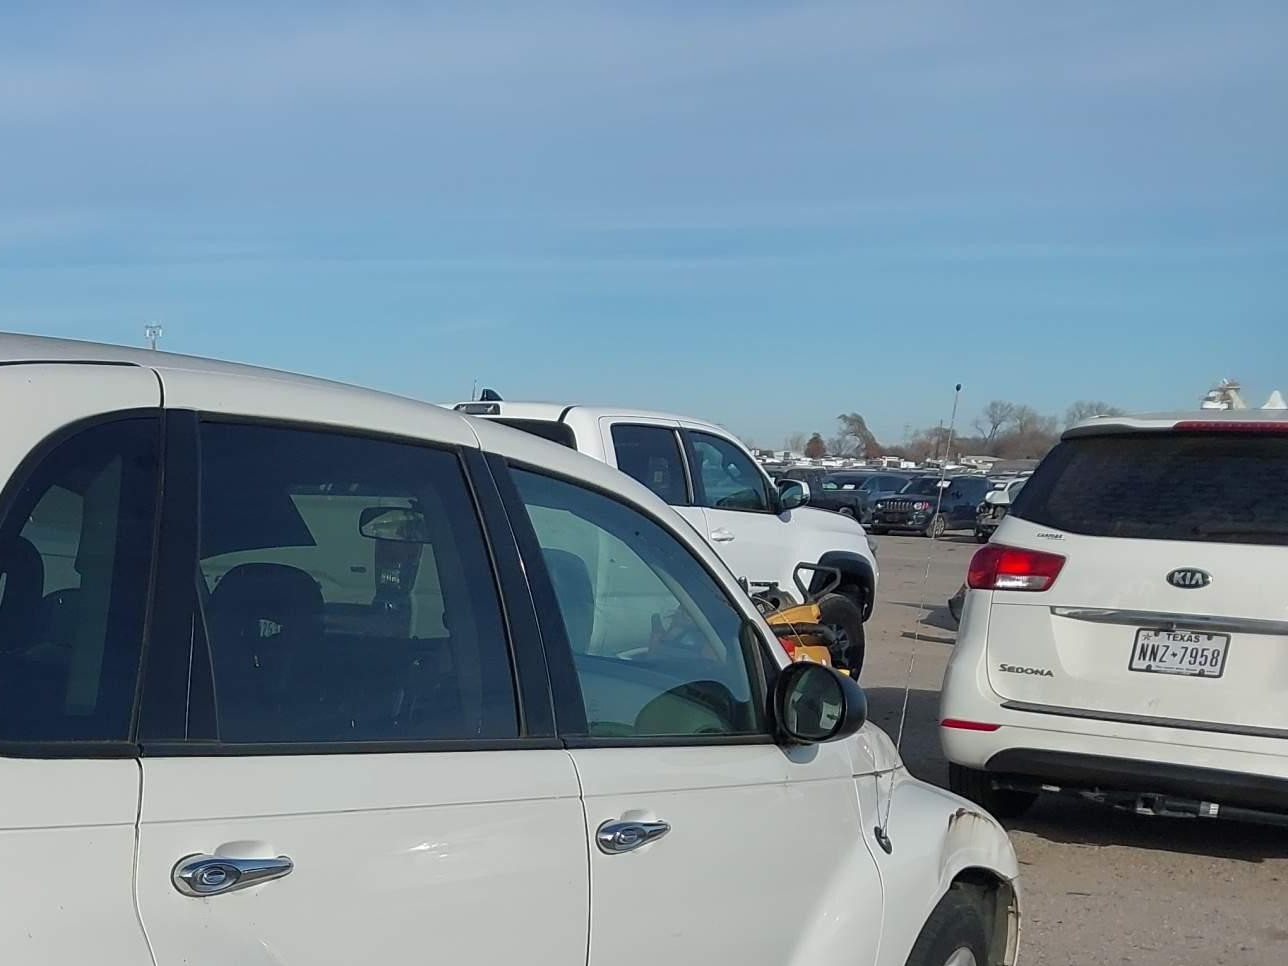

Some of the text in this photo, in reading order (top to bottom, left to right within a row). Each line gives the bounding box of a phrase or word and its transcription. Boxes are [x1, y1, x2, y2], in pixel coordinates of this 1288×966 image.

[1173, 571, 1204, 585] KIA
[1166, 632, 1201, 643] TEXAS
[998, 663, 1054, 678] SEDONA
